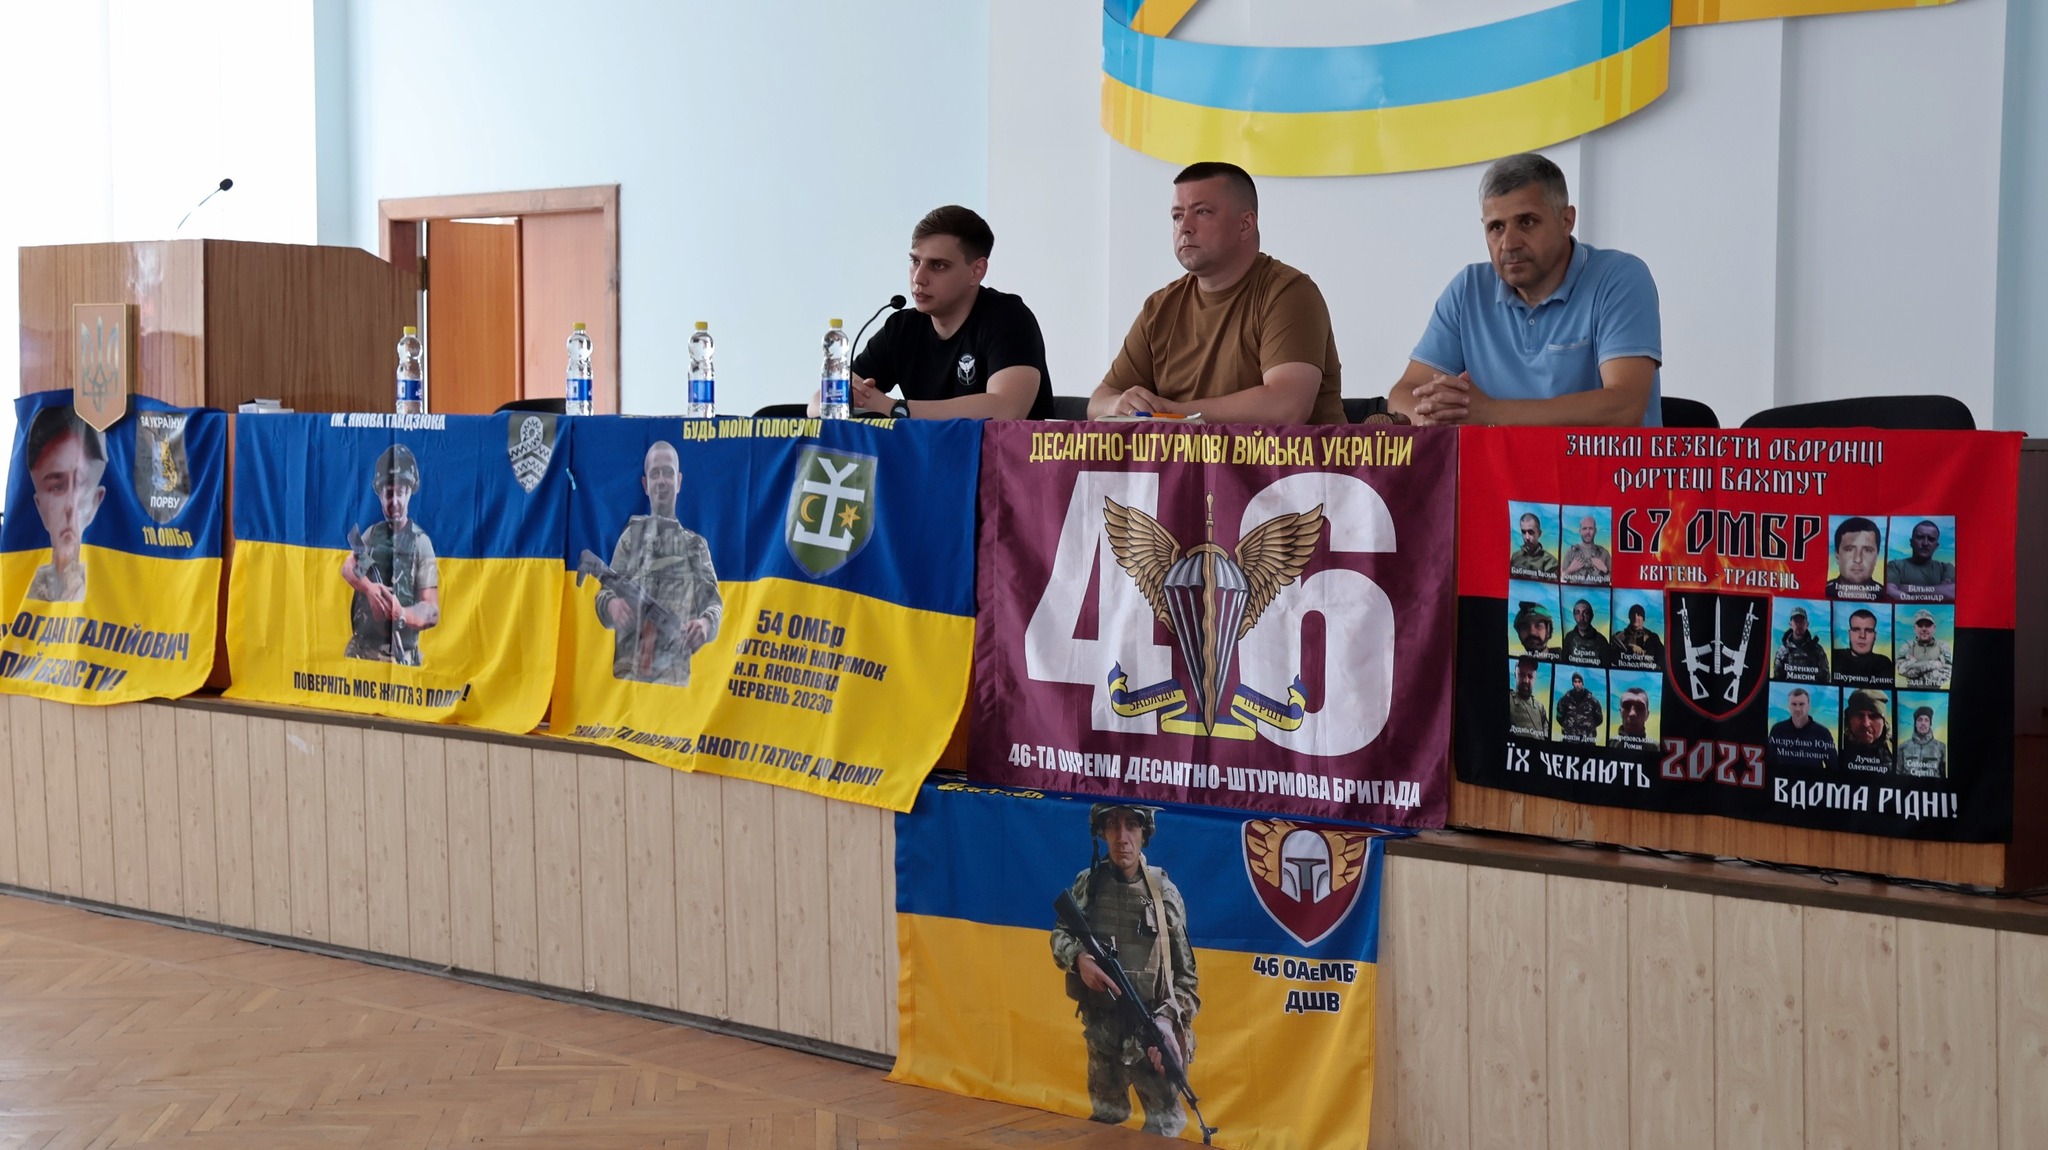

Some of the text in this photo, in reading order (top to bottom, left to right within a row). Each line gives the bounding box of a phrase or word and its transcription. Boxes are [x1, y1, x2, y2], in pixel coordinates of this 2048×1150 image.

[330, 413, 445, 431] ІМ. ЯКОВА ГАНДЗЮКА
[683, 418, 823, 442] БУДЬ МОЇМ ГОЛОСОМ!
[1029, 430, 1414, 467] ДЕСАНТНО-ШТУРМОВІ ВІЙСЬКА УКРАЇНИ
[1566, 435, 1884, 467] ЗНИКЛІ БЕЗВІСТИ ОБОРОНЦІ
[1613, 467, 1828, 496] ФОРТЕЦІ БАХМУТ
[150, 496, 180, 509] ПОРВУ
[158, 527, 193, 548] ОМБр
[1618, 508, 1821, 562] 67 ОМБР
[1639, 565, 1708, 583] КВІТЕНЬ
[1723, 568, 1800, 590] ТРАВЕНЬ
[11, 611, 69, 647] ОГДАН
[757, 609, 846, 648] 54 ОМБр
[1024, 470, 1398, 757] 46
[733, 661, 840, 692] Н.П. ЯКОВЛІВКА
[809, 648, 887, 682] НАПРЯМОК
[293, 671, 350, 695] ПОВЕРНІТЬ
[353, 678, 377, 699] МОЄ
[379, 682, 414, 705] ЖИТТЯ
[416, 687, 423, 706] З
[728, 678, 790, 705] ЧЕРВЕНЬ
[691, 734, 751, 761] АНОГО
[759, 744, 814, 773] ТАТУСЯ
[808, 757, 885, 787] ДОДОМУ!
[1008, 743, 1421, 810] 46-ТА ОКРЕМА ДЕСАНТНО-ШТУРМОВА БРИГАДА
[1506, 743, 1650, 788] ЇХ ЧЕКАЮТЬ
[1662, 738, 1764, 787] 2023
[1847, 762, 1888, 774] Олександр
[1774, 777, 1957, 821] ВДОМА РІДНІ!
[1253, 956, 1280, 977] 46
[1284, 990, 1340, 1014] ДШВ
